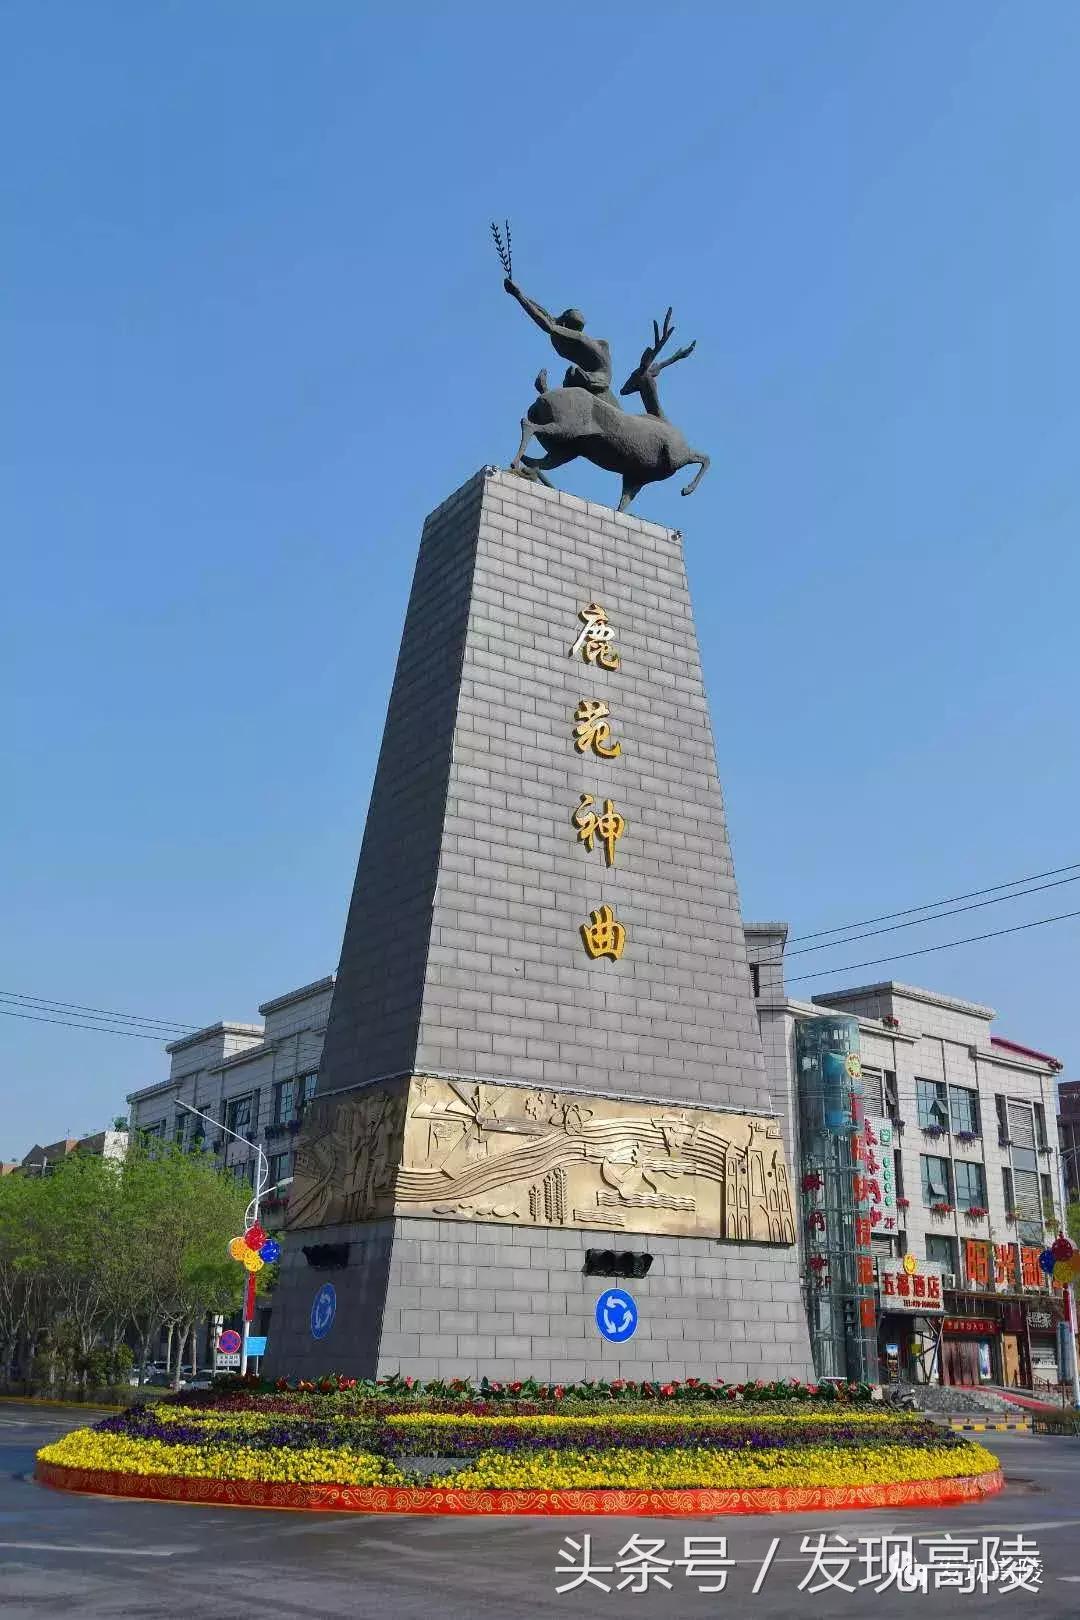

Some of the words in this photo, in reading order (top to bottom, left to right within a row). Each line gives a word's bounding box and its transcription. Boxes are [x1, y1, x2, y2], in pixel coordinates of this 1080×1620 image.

[568, 603, 627, 962] 鹿苑神曲
[881, 1271, 941, 1298] 五福酒店
